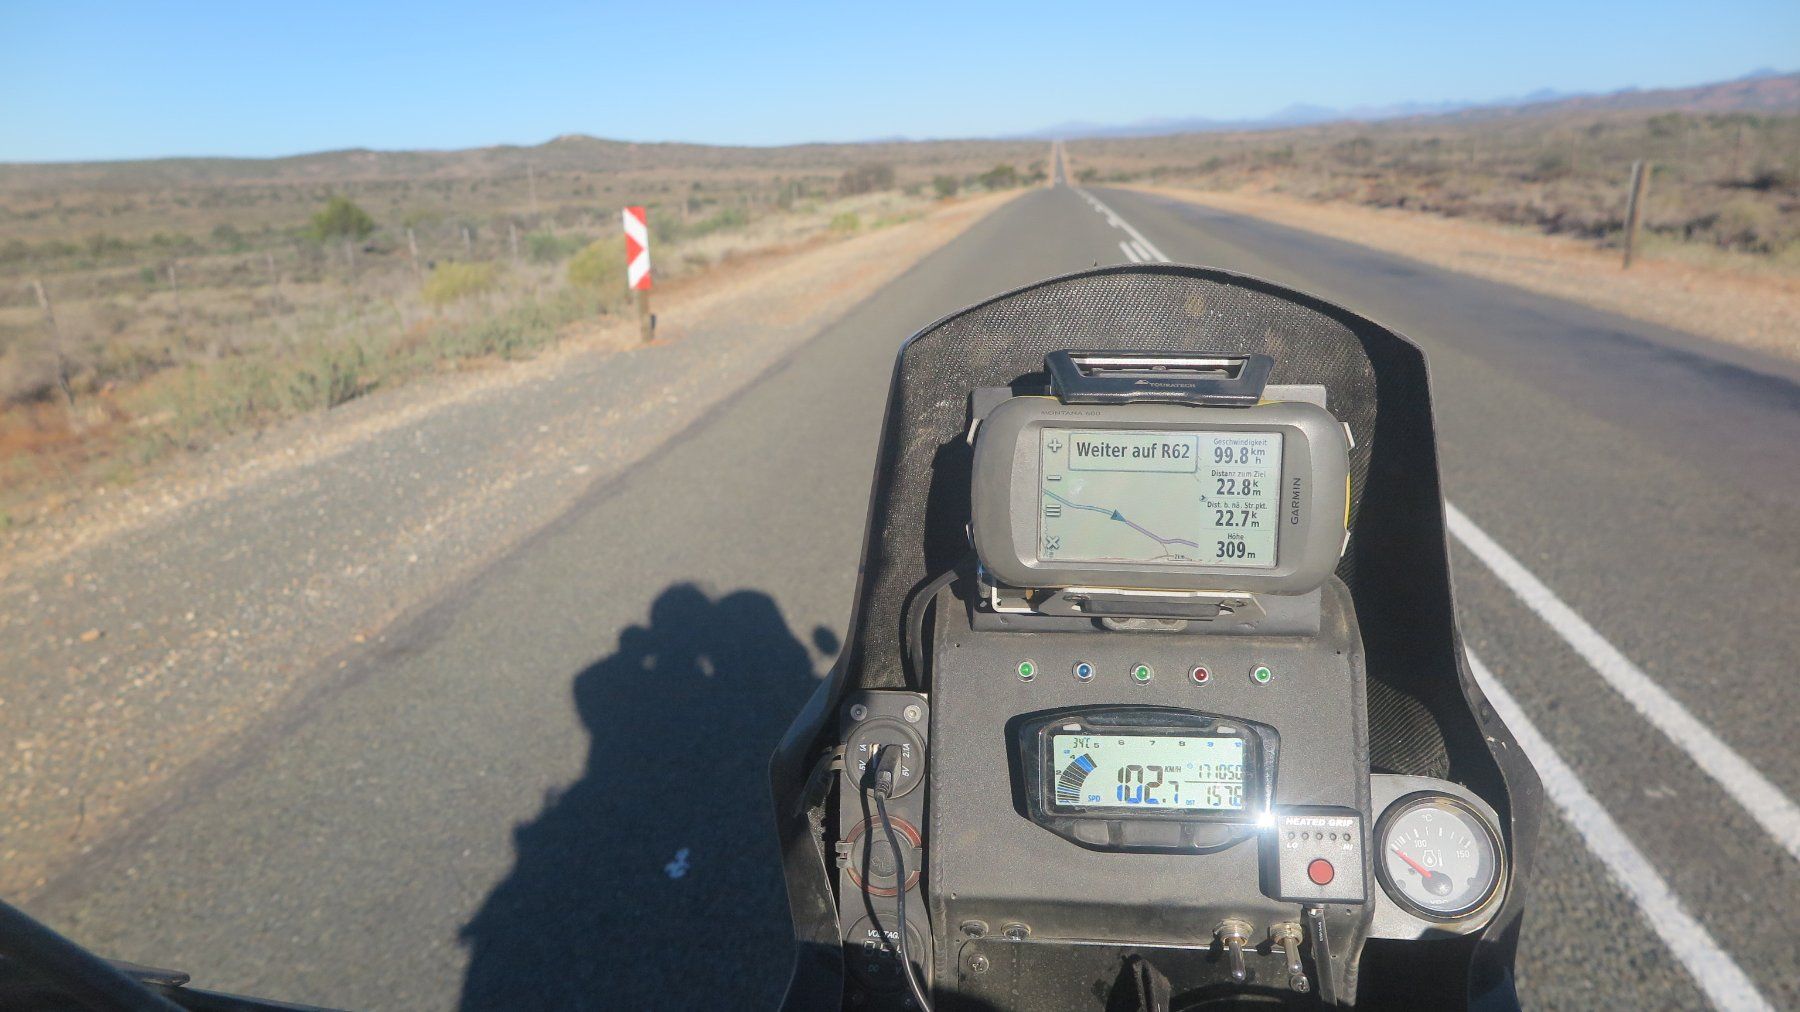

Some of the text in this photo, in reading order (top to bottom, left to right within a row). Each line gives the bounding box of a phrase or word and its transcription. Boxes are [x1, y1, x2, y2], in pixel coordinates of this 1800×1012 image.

[1076, 441, 1190, 459] Weiter auf R62
[1213, 438, 1268, 446] Geschwindigkeit
[1214, 446, 1249, 465] 99.8
[1211, 469, 1235, 477] Distanz
[1253, 470, 1266, 478] Ziel
[1216, 478, 1251, 496] 22.8
[1290, 477, 1301, 525] GARMIN
[1215, 510, 1249, 527] 22.7
[1216, 541, 1246, 558] 309
[1116, 764, 1179, 804] 102.7
[1088, 794, 1101, 802] SPD
[1285, 817, 1354, 827] HEATED GRIP
[1456, 850, 1470, 858] 150
